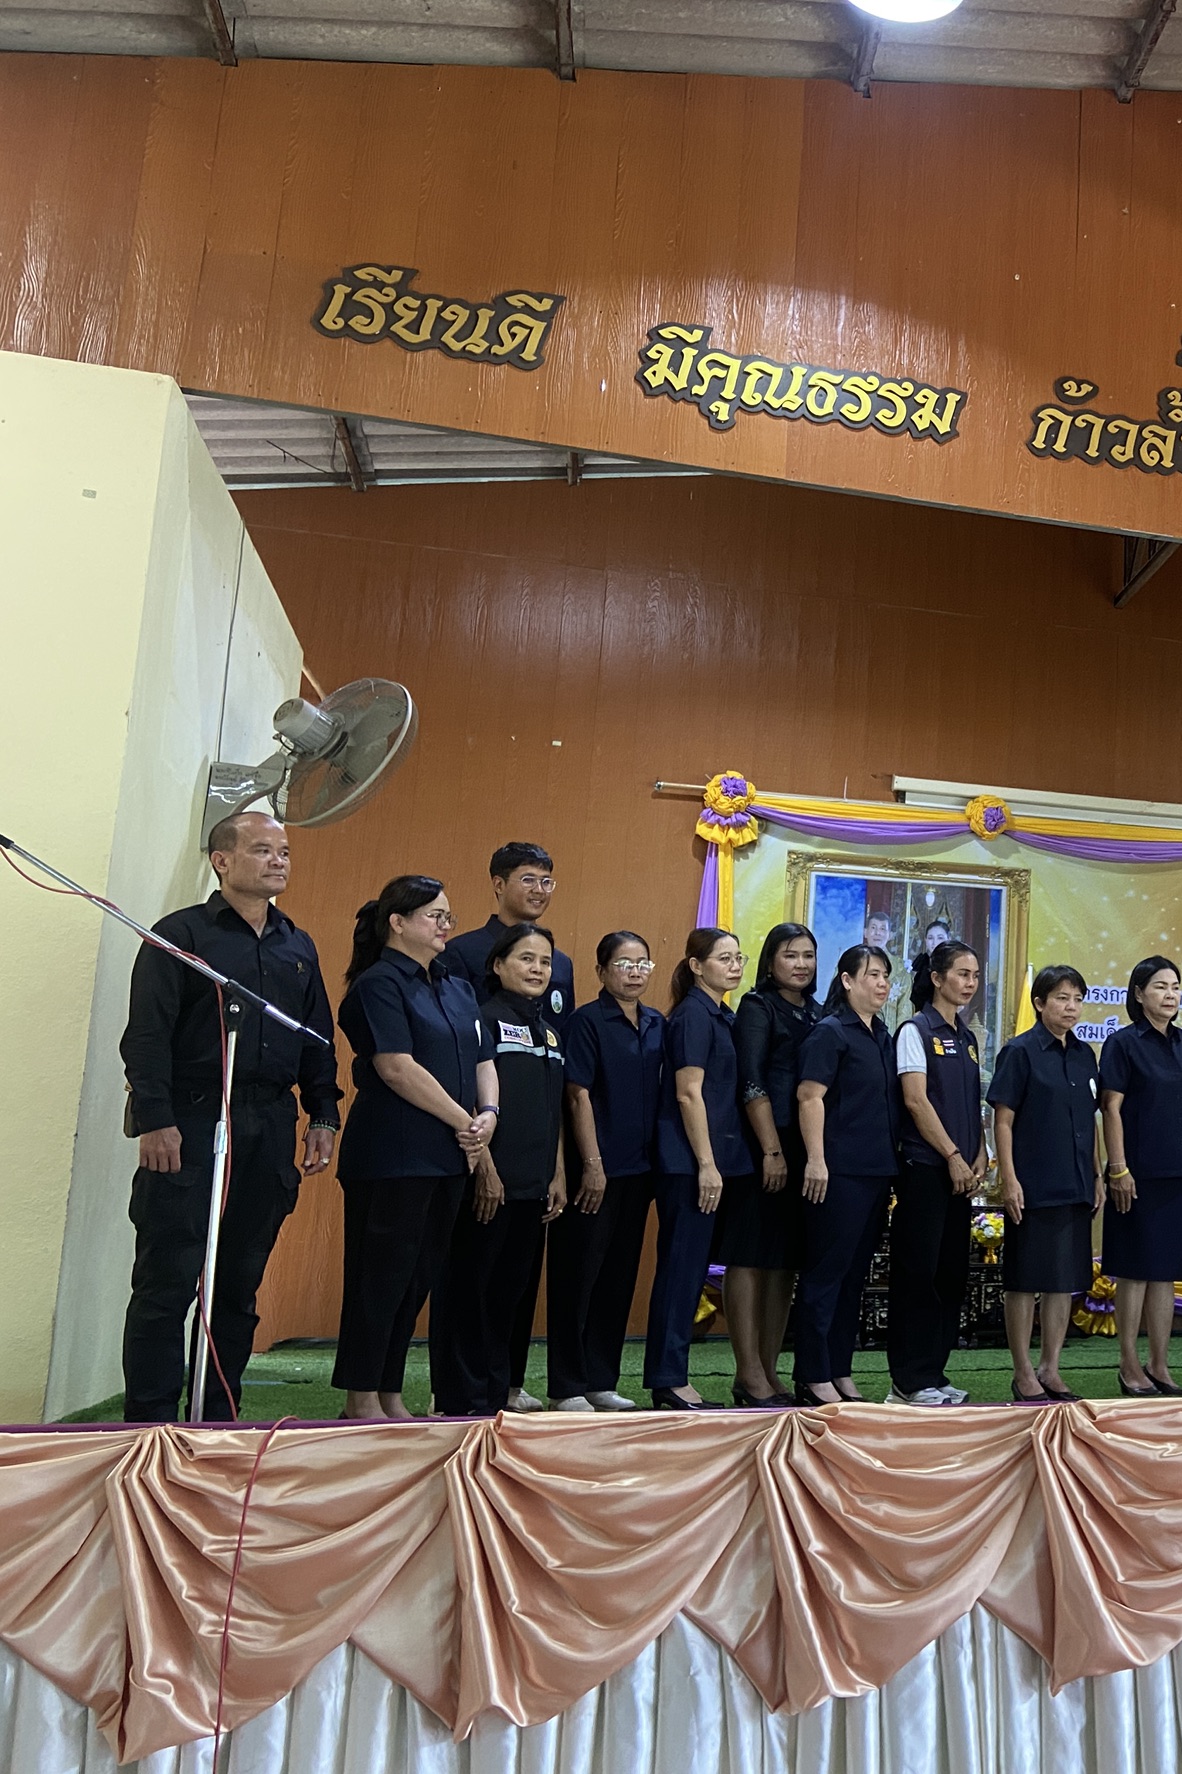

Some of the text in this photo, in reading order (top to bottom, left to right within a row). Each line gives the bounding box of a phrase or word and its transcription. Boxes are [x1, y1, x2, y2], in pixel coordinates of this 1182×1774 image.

[319, 266, 554, 362] เรียนดี
[643, 325, 960, 435] มีคุณธรรม
